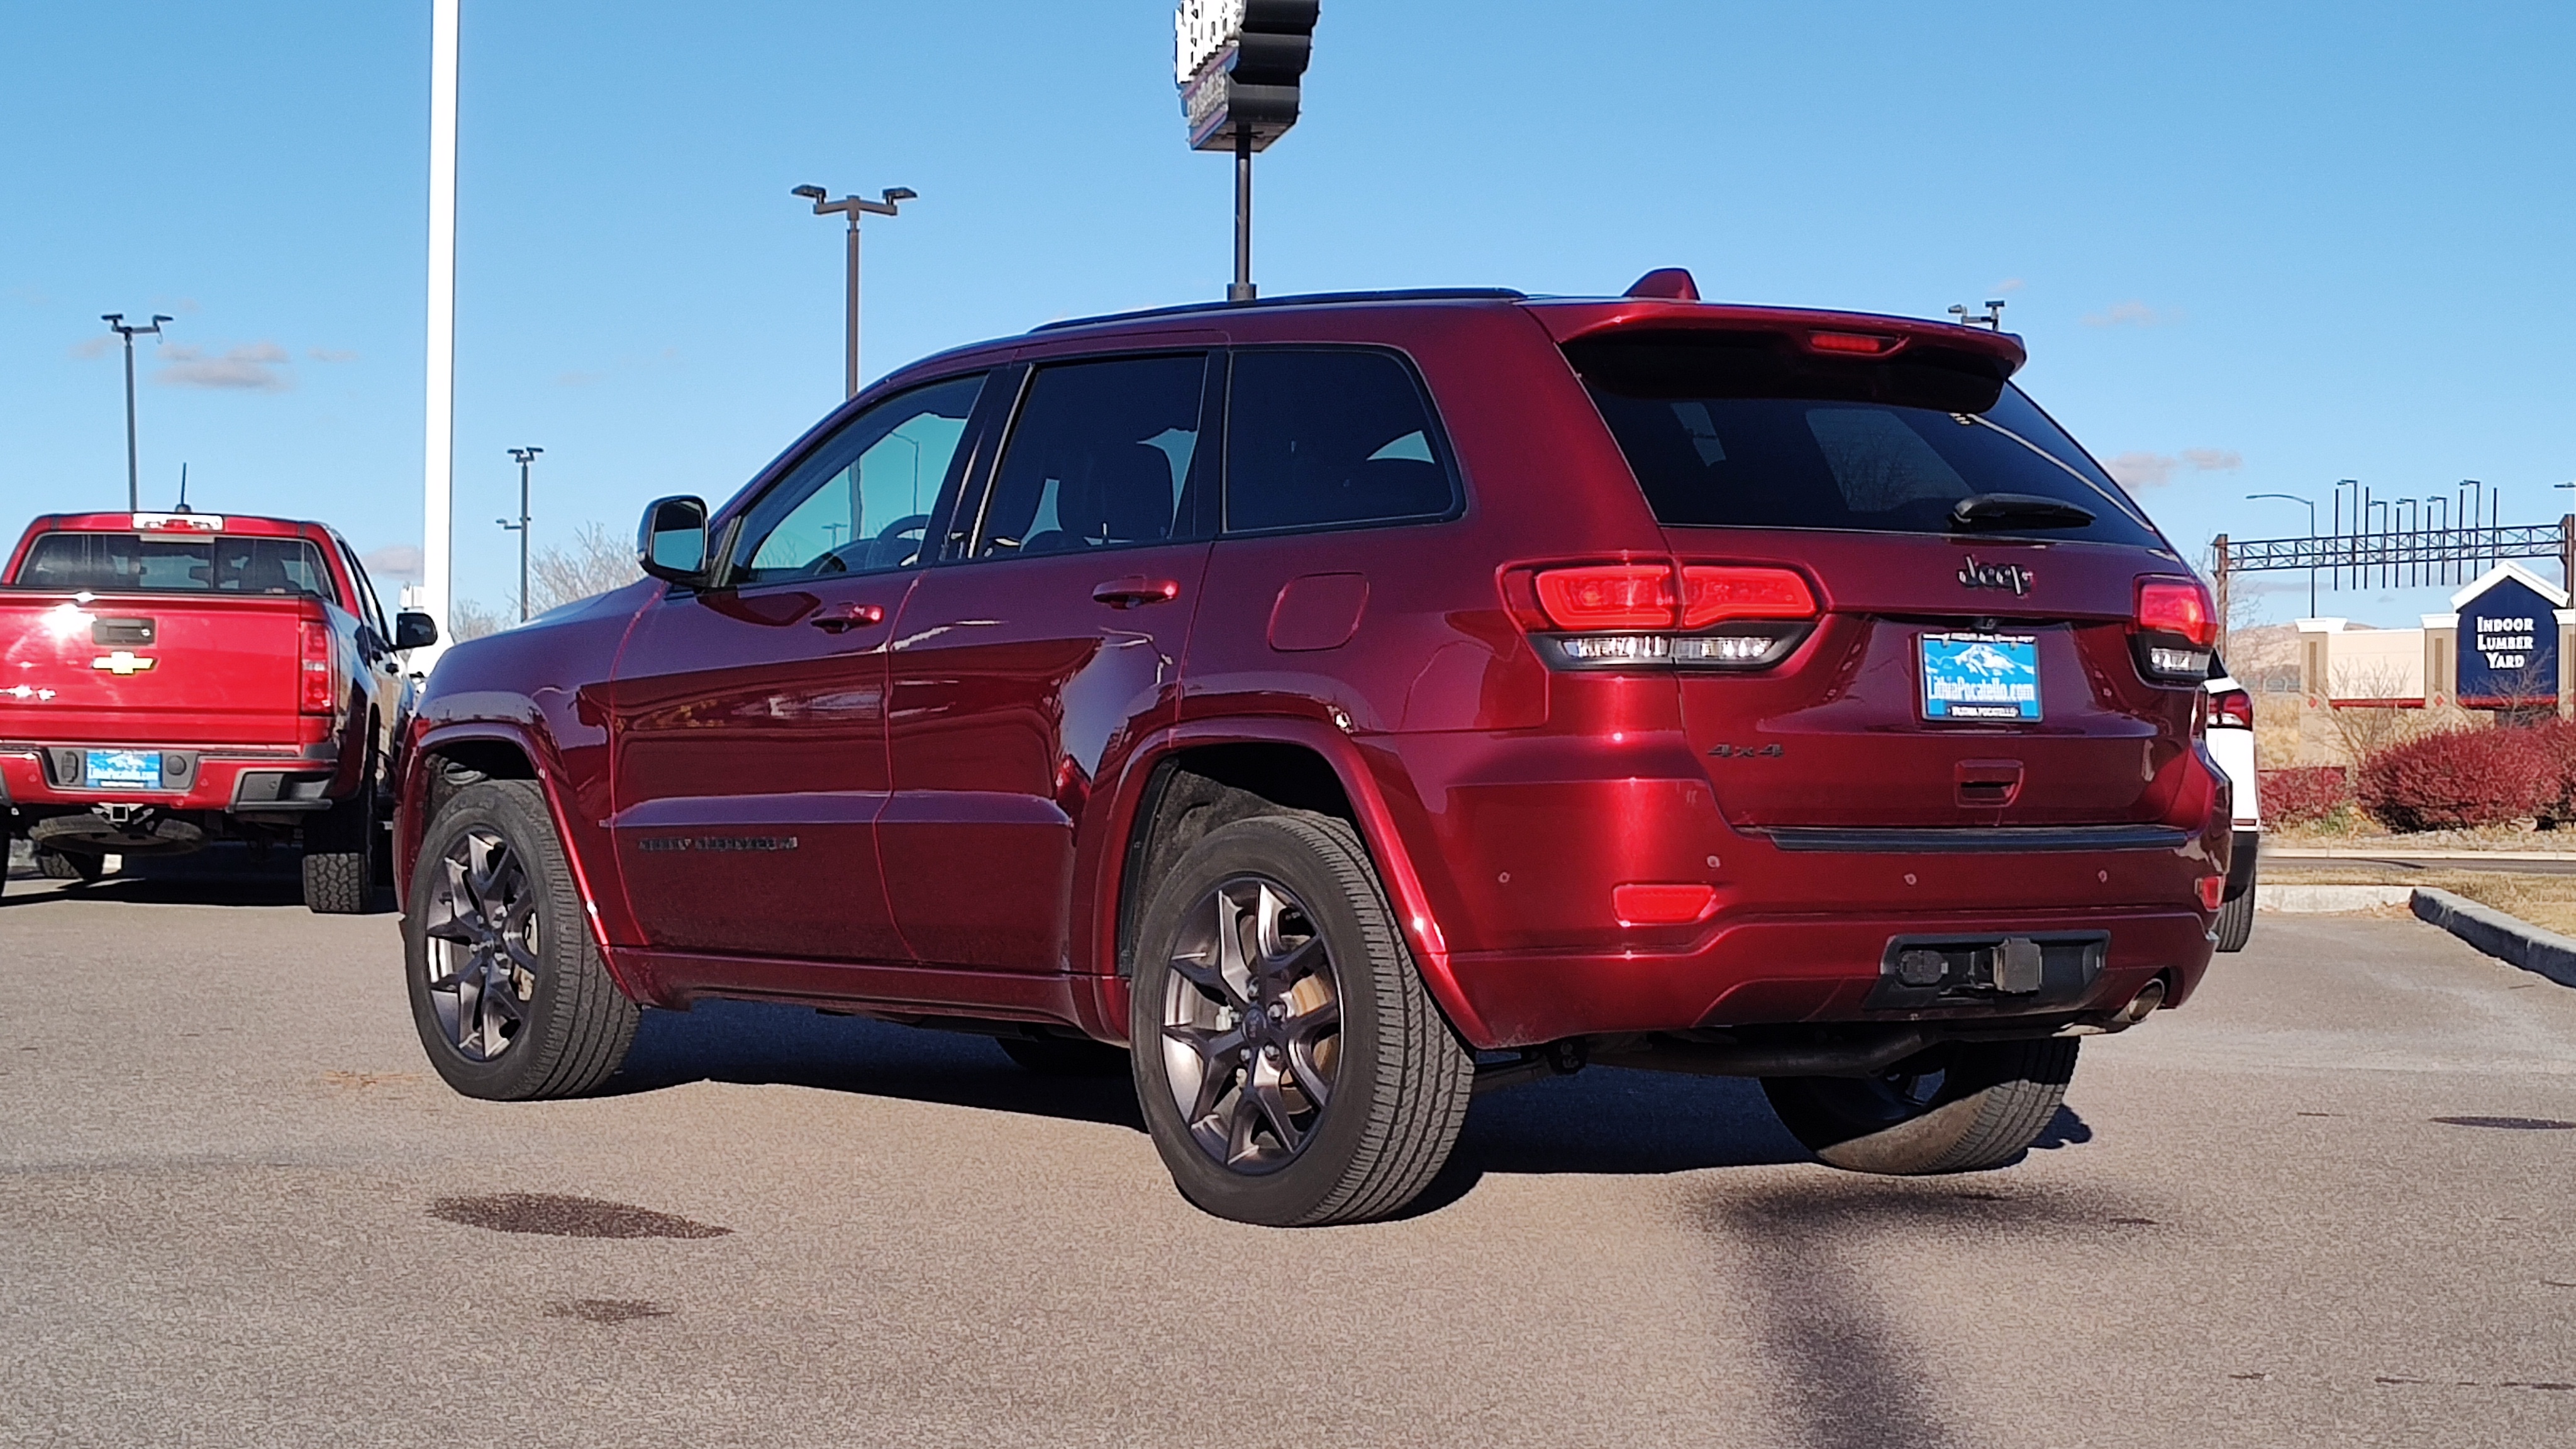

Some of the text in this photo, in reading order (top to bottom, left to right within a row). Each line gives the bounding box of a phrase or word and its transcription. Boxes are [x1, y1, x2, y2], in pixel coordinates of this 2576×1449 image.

[1957, 555, 2032, 596] Jeep
[2477, 616, 2534, 633] INDOOR
[2477, 634, 2534, 651] LUMBER
[2485, 652, 2525, 669] YARD
[1927, 675, 2035, 701] LithiaPocatello.com
